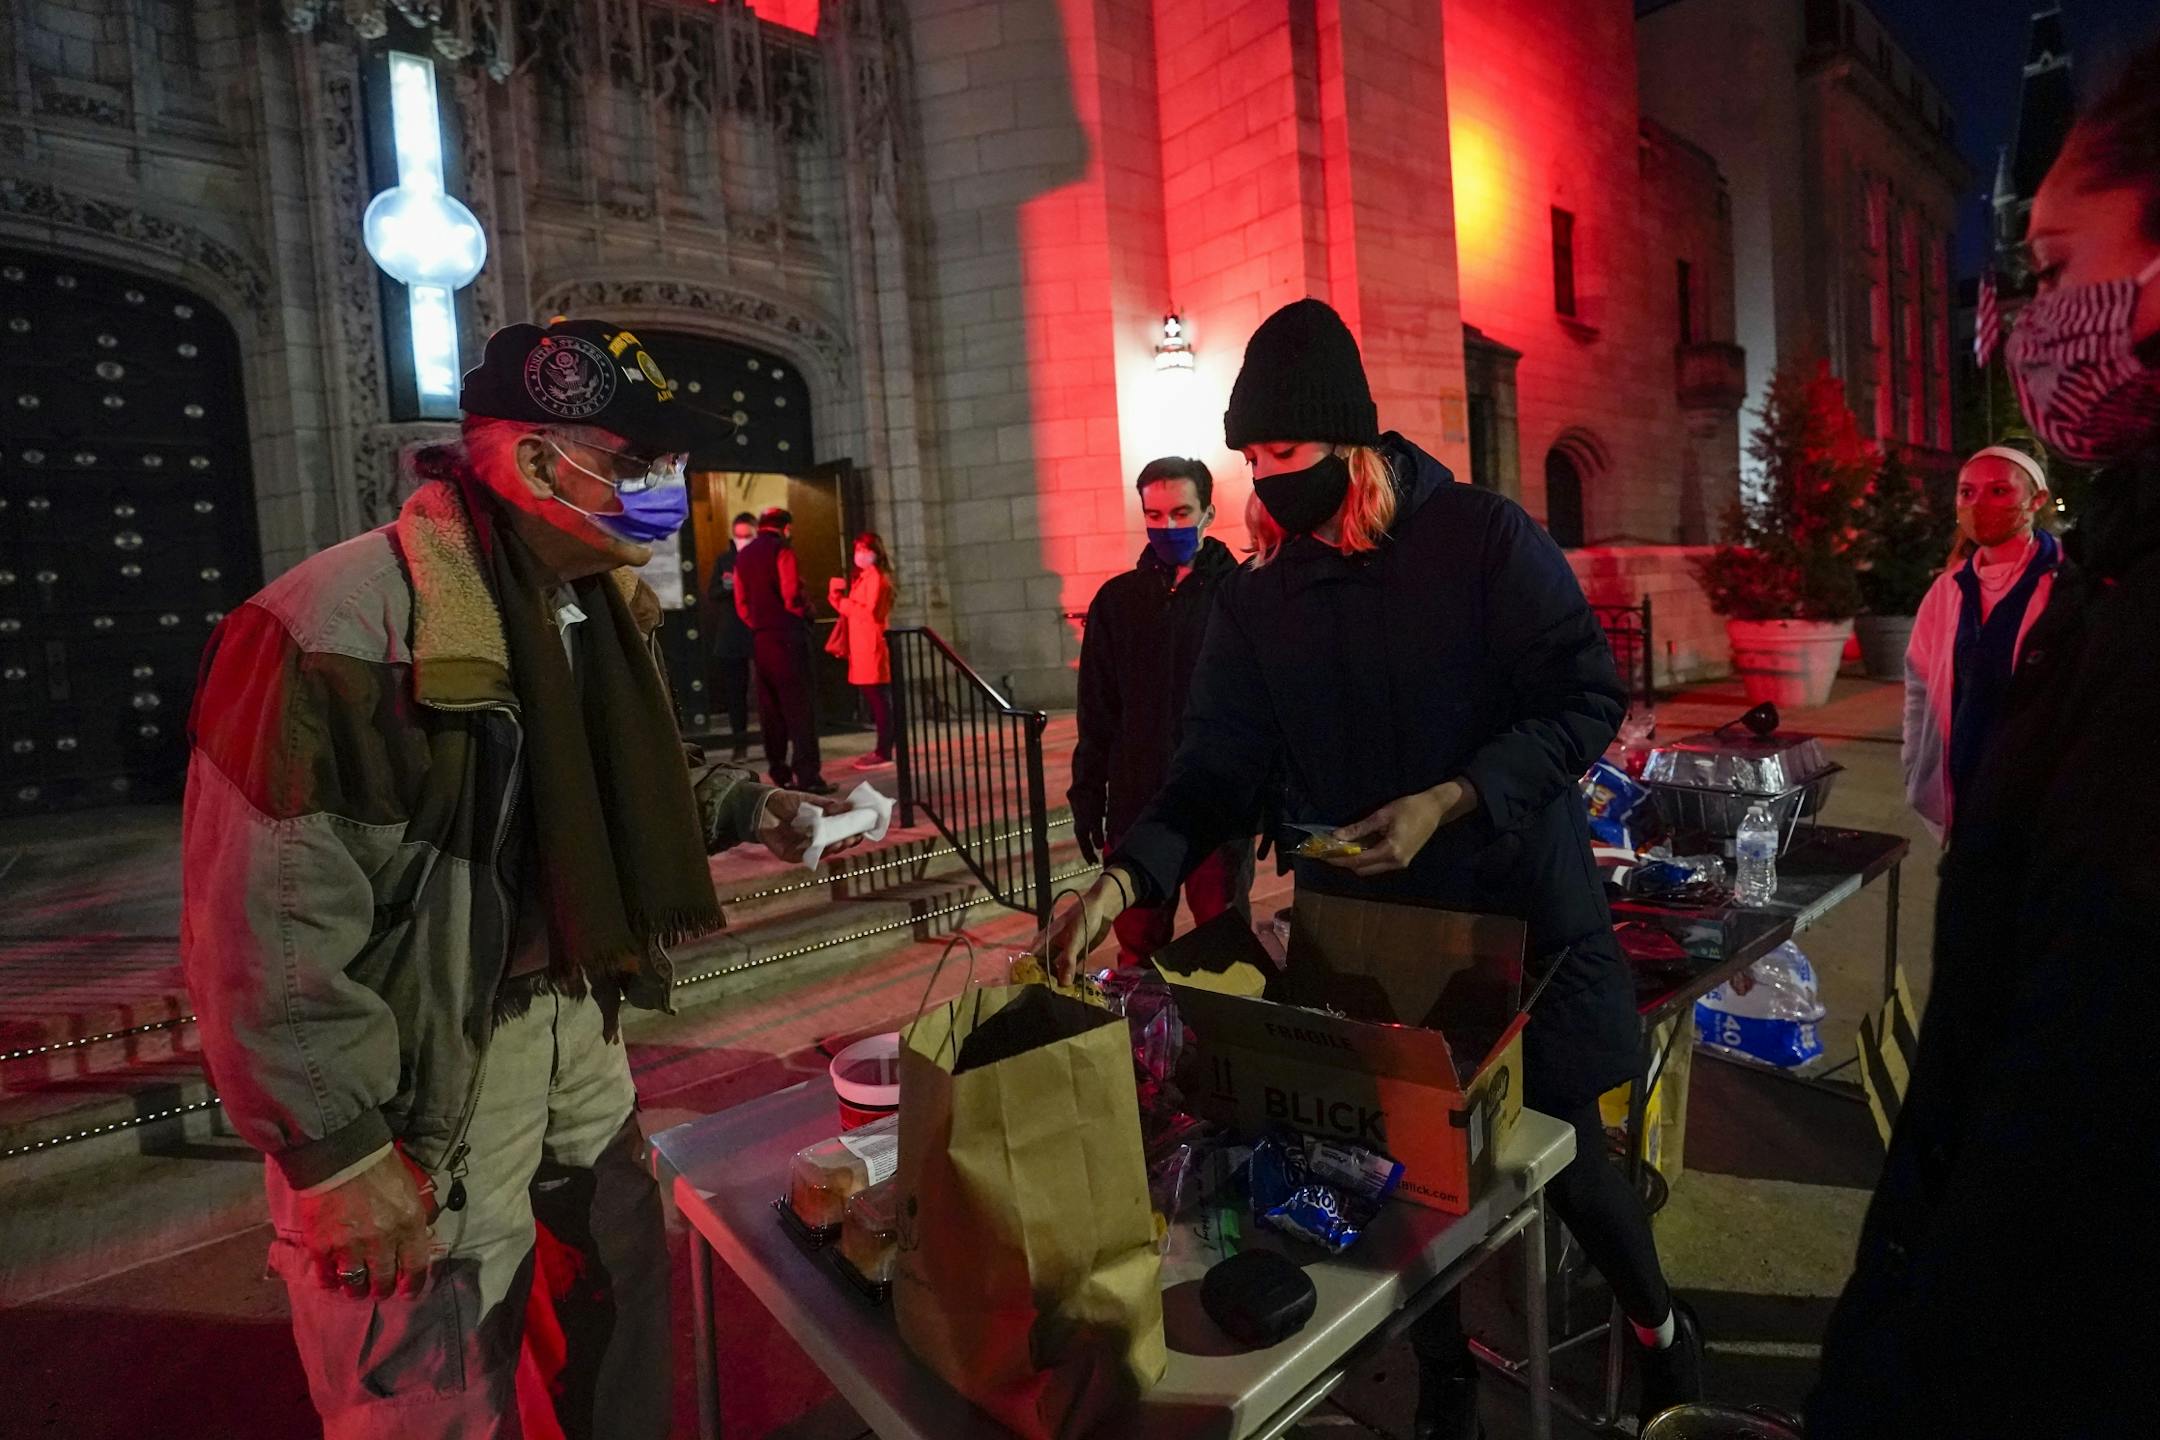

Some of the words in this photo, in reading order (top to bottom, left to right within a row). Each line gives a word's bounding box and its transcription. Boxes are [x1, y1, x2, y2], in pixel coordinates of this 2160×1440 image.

[559, 337, 603, 361] STATES
[560, 399, 599, 416] ARMY
[1264, 1022, 1356, 1052] FRAGILE
[1722, 1014, 1742, 1047] 40
[1264, 1086, 1388, 1143] BLICK
